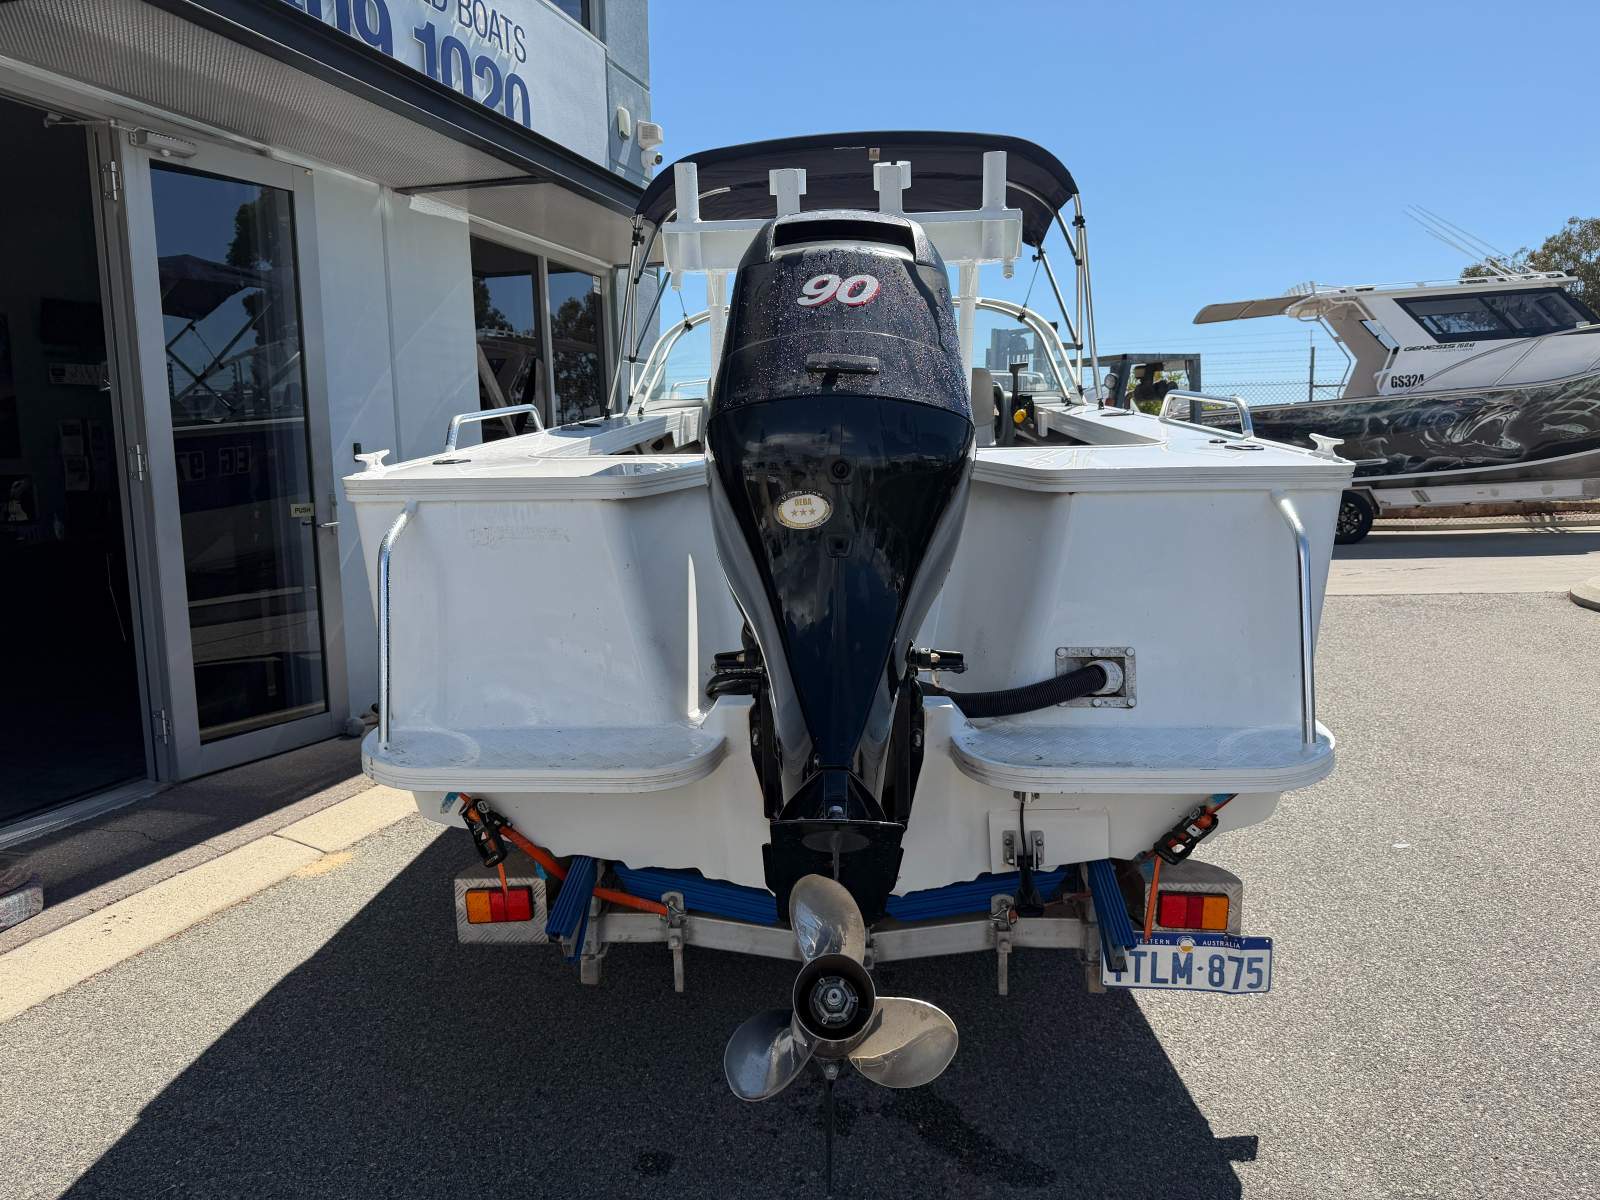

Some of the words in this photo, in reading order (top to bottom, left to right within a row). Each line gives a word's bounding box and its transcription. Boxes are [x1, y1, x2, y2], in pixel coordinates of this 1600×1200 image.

[458, 0, 527, 63] BOATS
[413, 21, 531, 130] 1020
[796, 273, 881, 308] 90
[1403, 344, 1456, 352] GENESIS
[1202, 939, 1241, 949] AUSTRALIA
